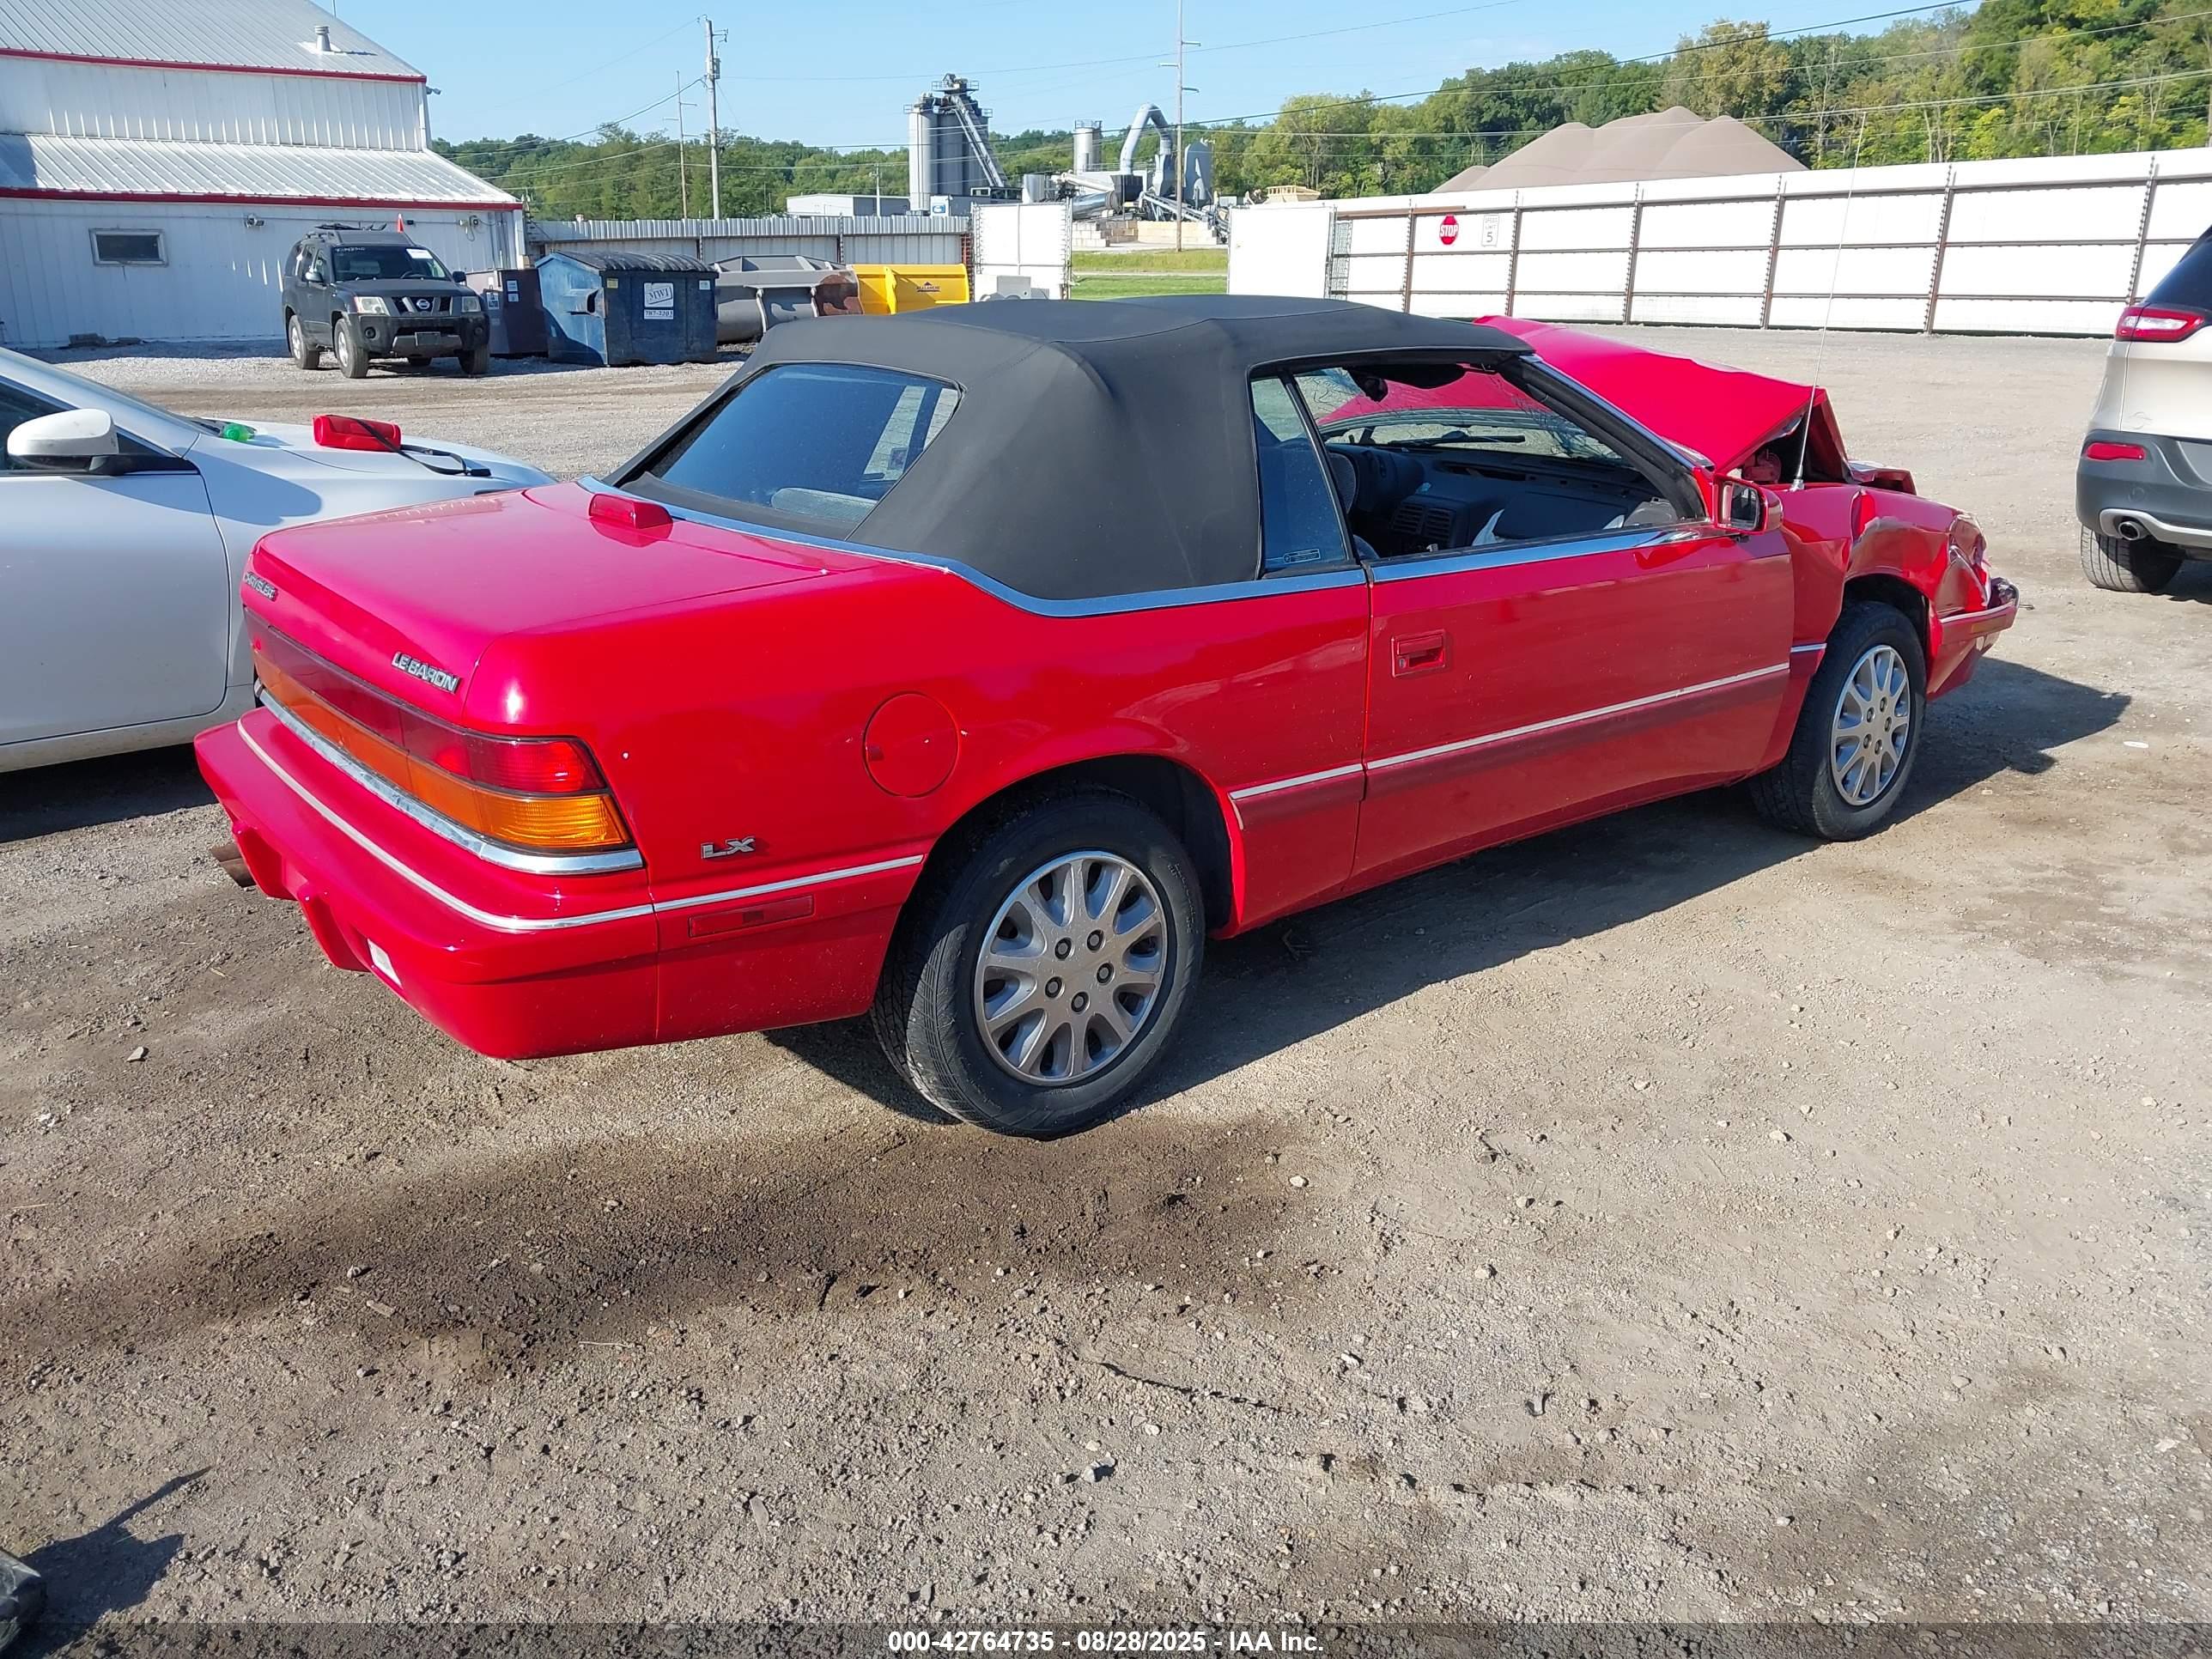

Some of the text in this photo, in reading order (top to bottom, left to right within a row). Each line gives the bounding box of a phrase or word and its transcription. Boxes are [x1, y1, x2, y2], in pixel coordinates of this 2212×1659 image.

[1440, 225, 1458, 237] STOP
[1486, 231, 1493, 243] 5
[647, 288, 670, 301] MWI
[701, 836, 756, 859] LX
